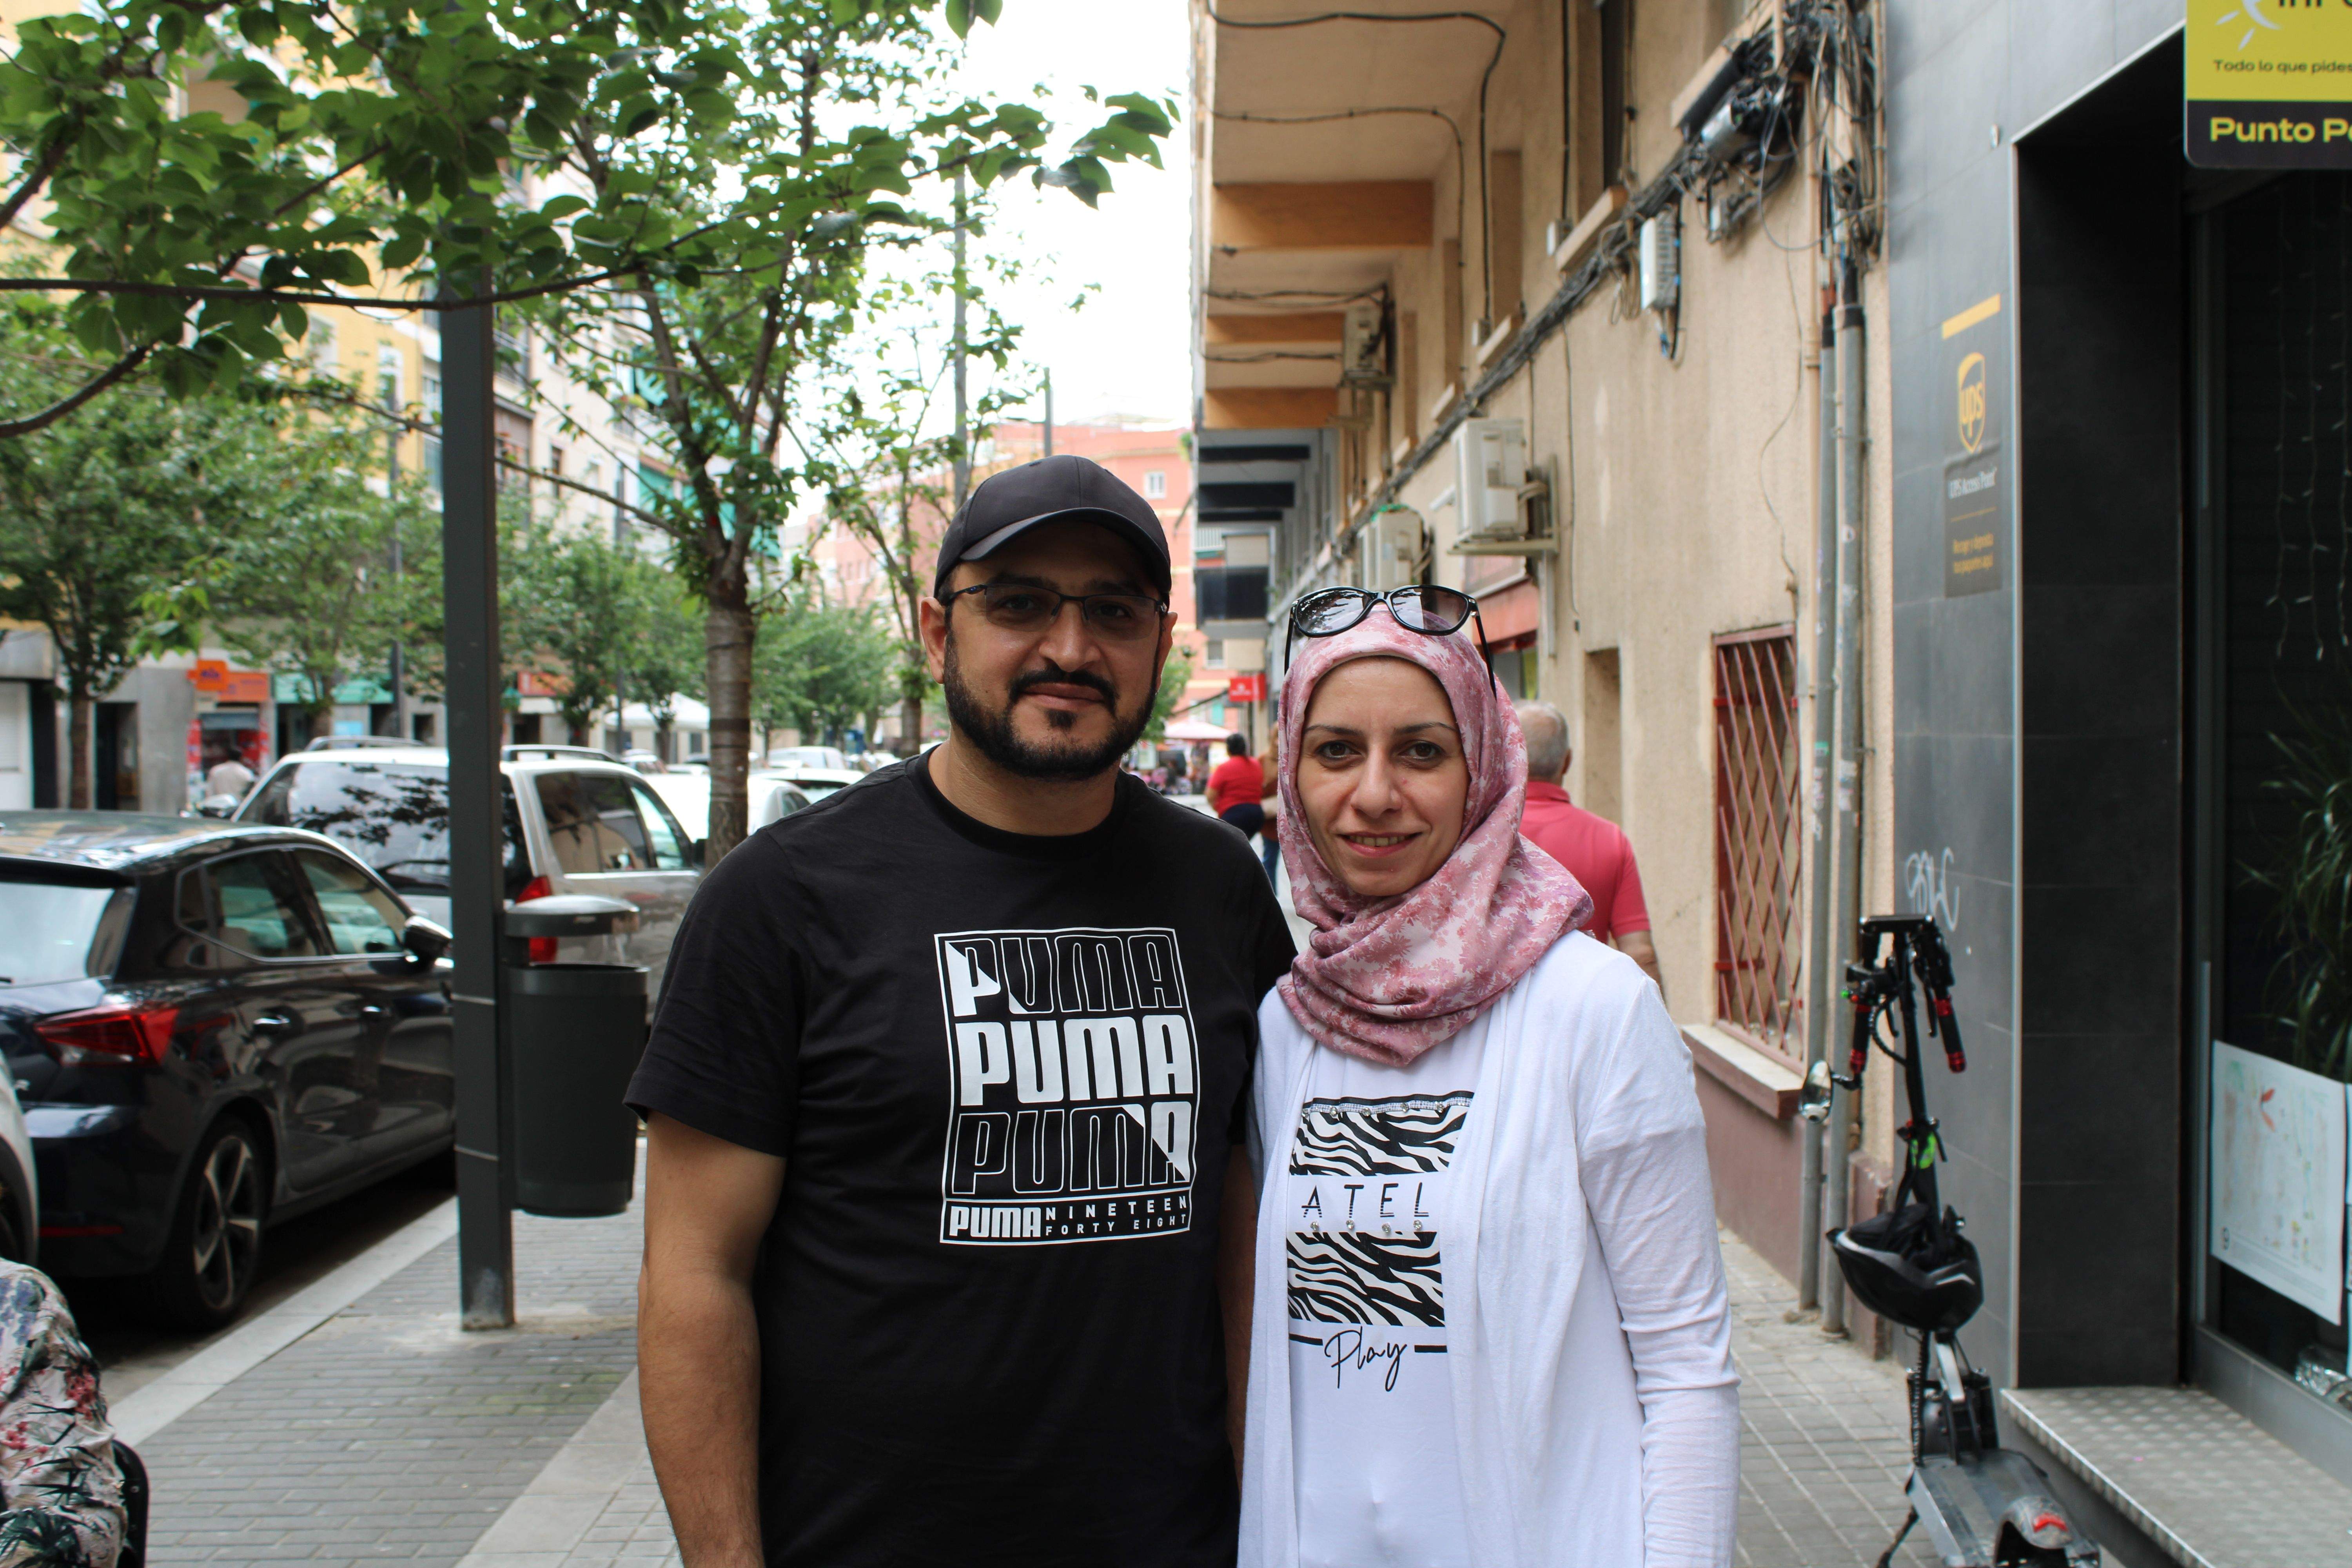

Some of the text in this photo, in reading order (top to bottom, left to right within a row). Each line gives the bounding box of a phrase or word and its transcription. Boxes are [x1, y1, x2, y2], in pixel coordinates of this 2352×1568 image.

[2214, 59, 2255, 72] Todo
[2258, 60, 2273, 72] lo
[2277, 62, 2308, 74] que
[2210, 117, 2352, 143] Punto P
[945, 935, 1182, 1017] PUMA
[955, 1014, 1193, 1106] PUMA
[951, 1102, 1191, 1194] PUMA
[949, 1196, 1187, 1238] PUMA NINETEEN
[1046, 1214, 1186, 1236] FORTY EIGHT
[1324, 1326, 1407, 1392] Play
